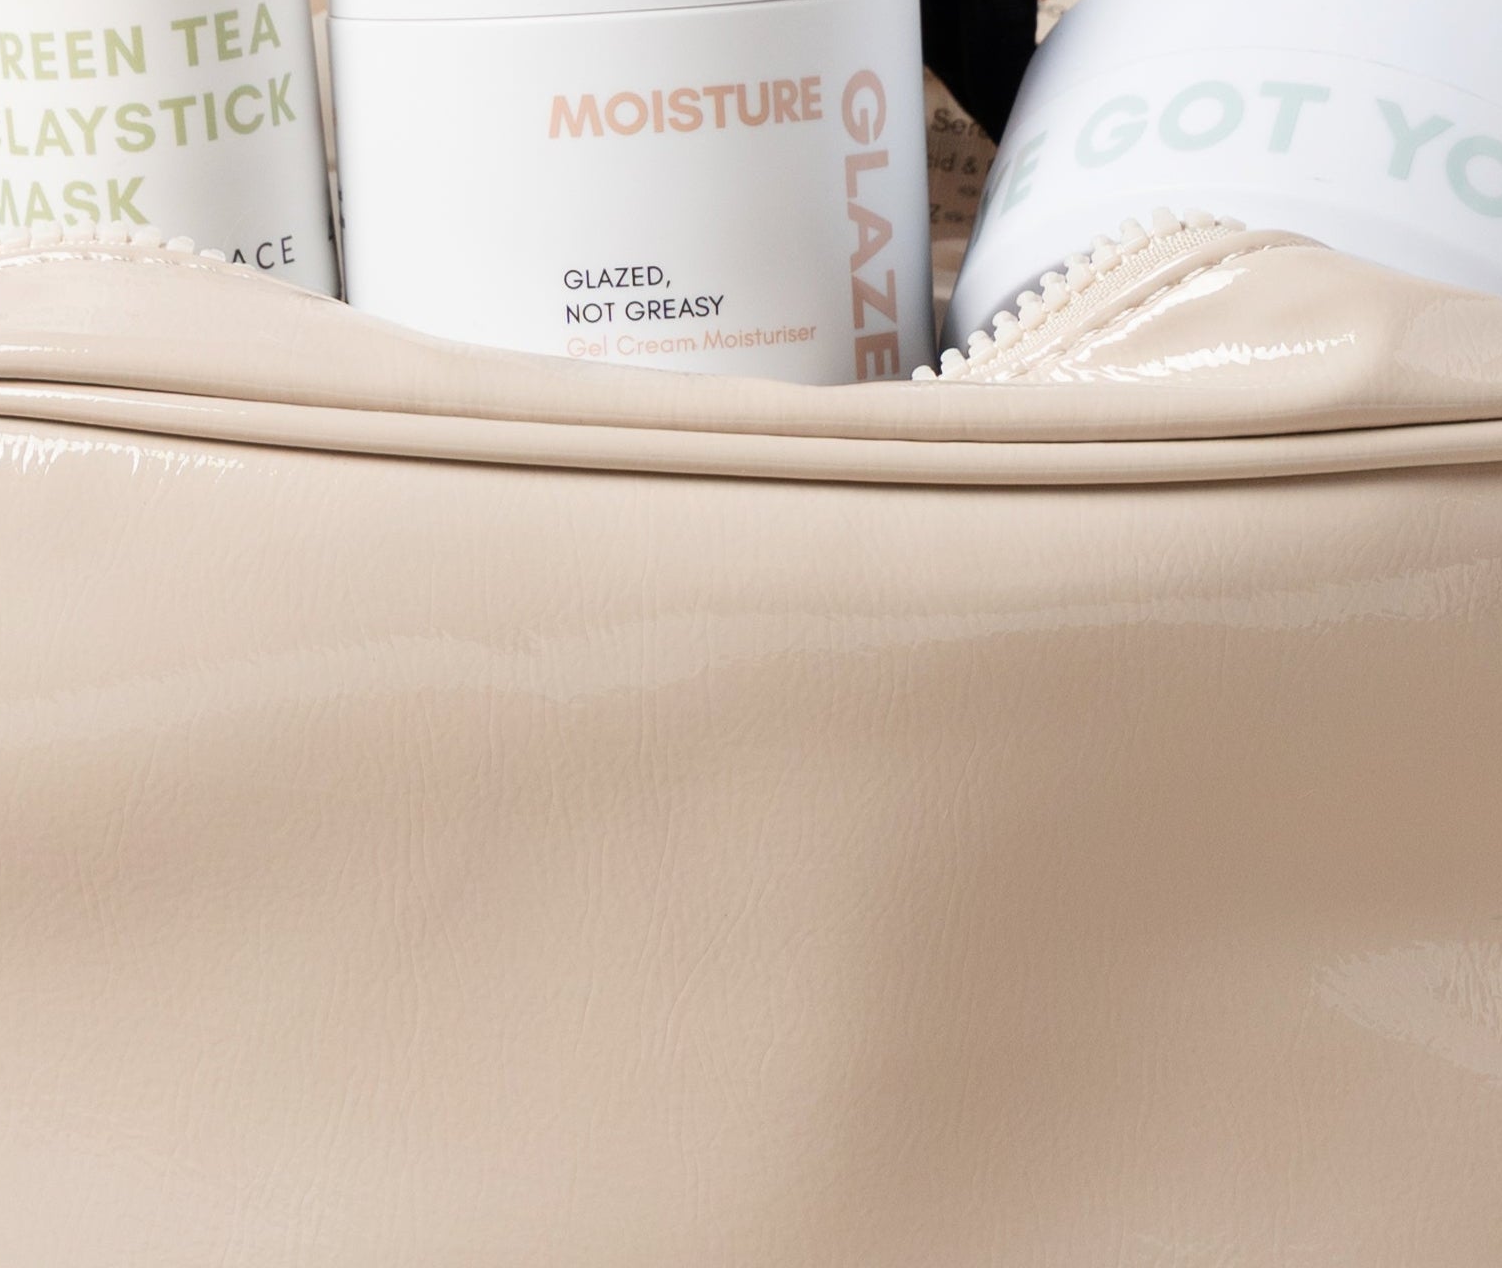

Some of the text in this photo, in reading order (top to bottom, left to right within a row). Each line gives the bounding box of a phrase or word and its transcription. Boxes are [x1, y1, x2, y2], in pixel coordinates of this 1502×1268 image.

[170, 1, 282, 70] TEA
[548, 76, 823, 140] MOISTURE
[1074, 79, 1330, 170] GOT
[841, 69, 901, 380] GLAZE
[231, 234, 296, 270] ACE
[563, 265, 671, 290] GLAZED,
[566, 294, 725, 325] NOT GREASY
[566, 324, 817, 359] Gel Cream Moisturiser
